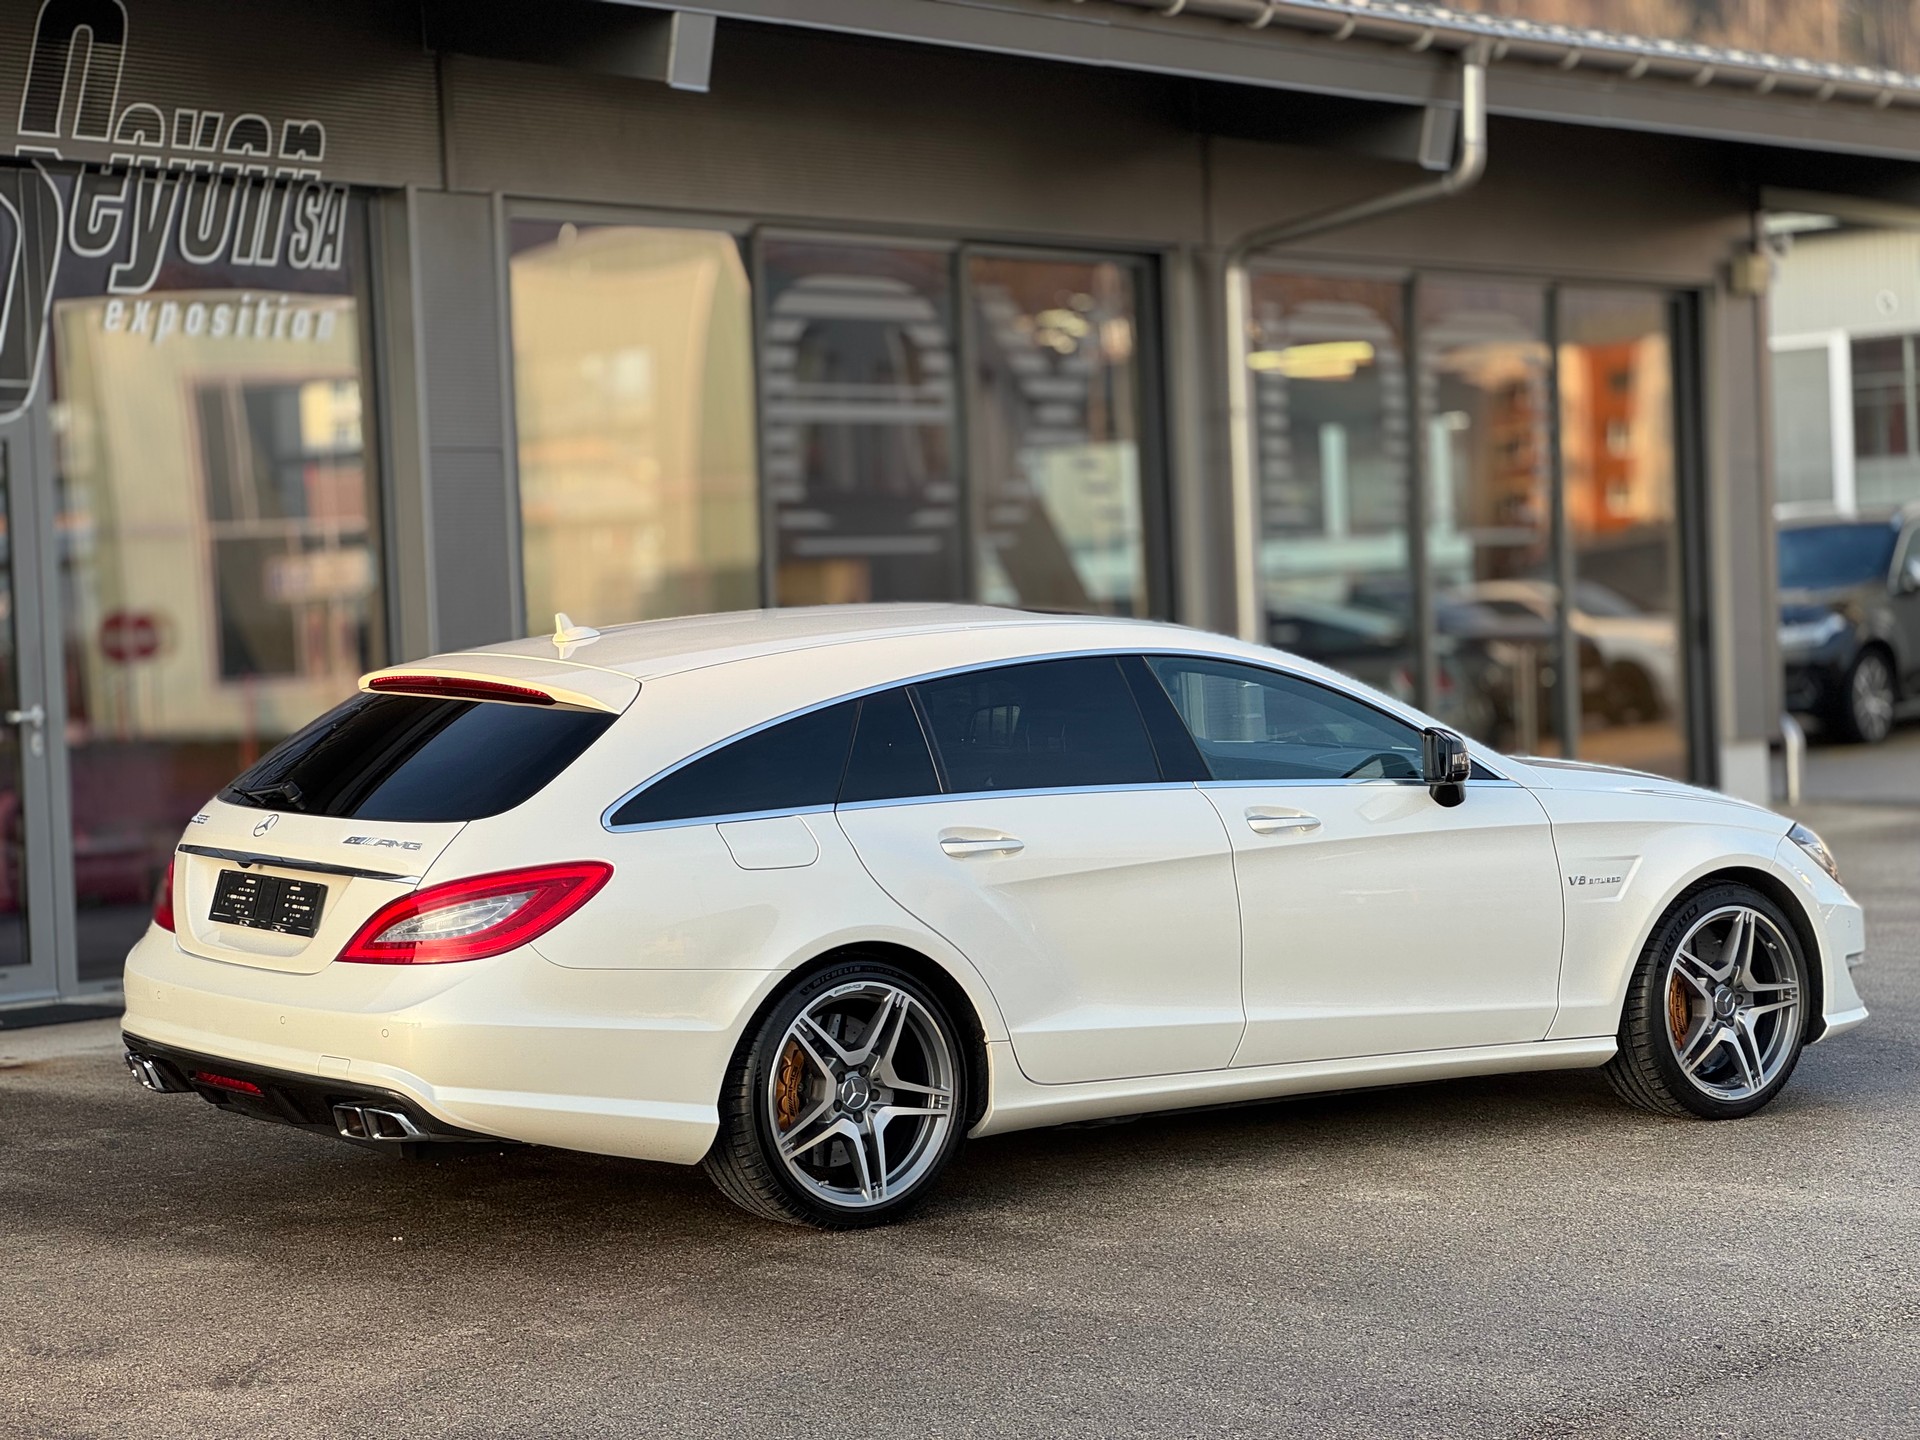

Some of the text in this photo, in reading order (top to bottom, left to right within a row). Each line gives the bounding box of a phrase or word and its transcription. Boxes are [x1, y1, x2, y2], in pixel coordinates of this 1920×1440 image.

[288, 182, 350, 270] SA
[103, 295, 338, 346] exposition
[1568, 875, 1587, 886] V8
[1659, 905, 1699, 964] MICHELIN
[812, 965, 862, 987] MICHELIN
